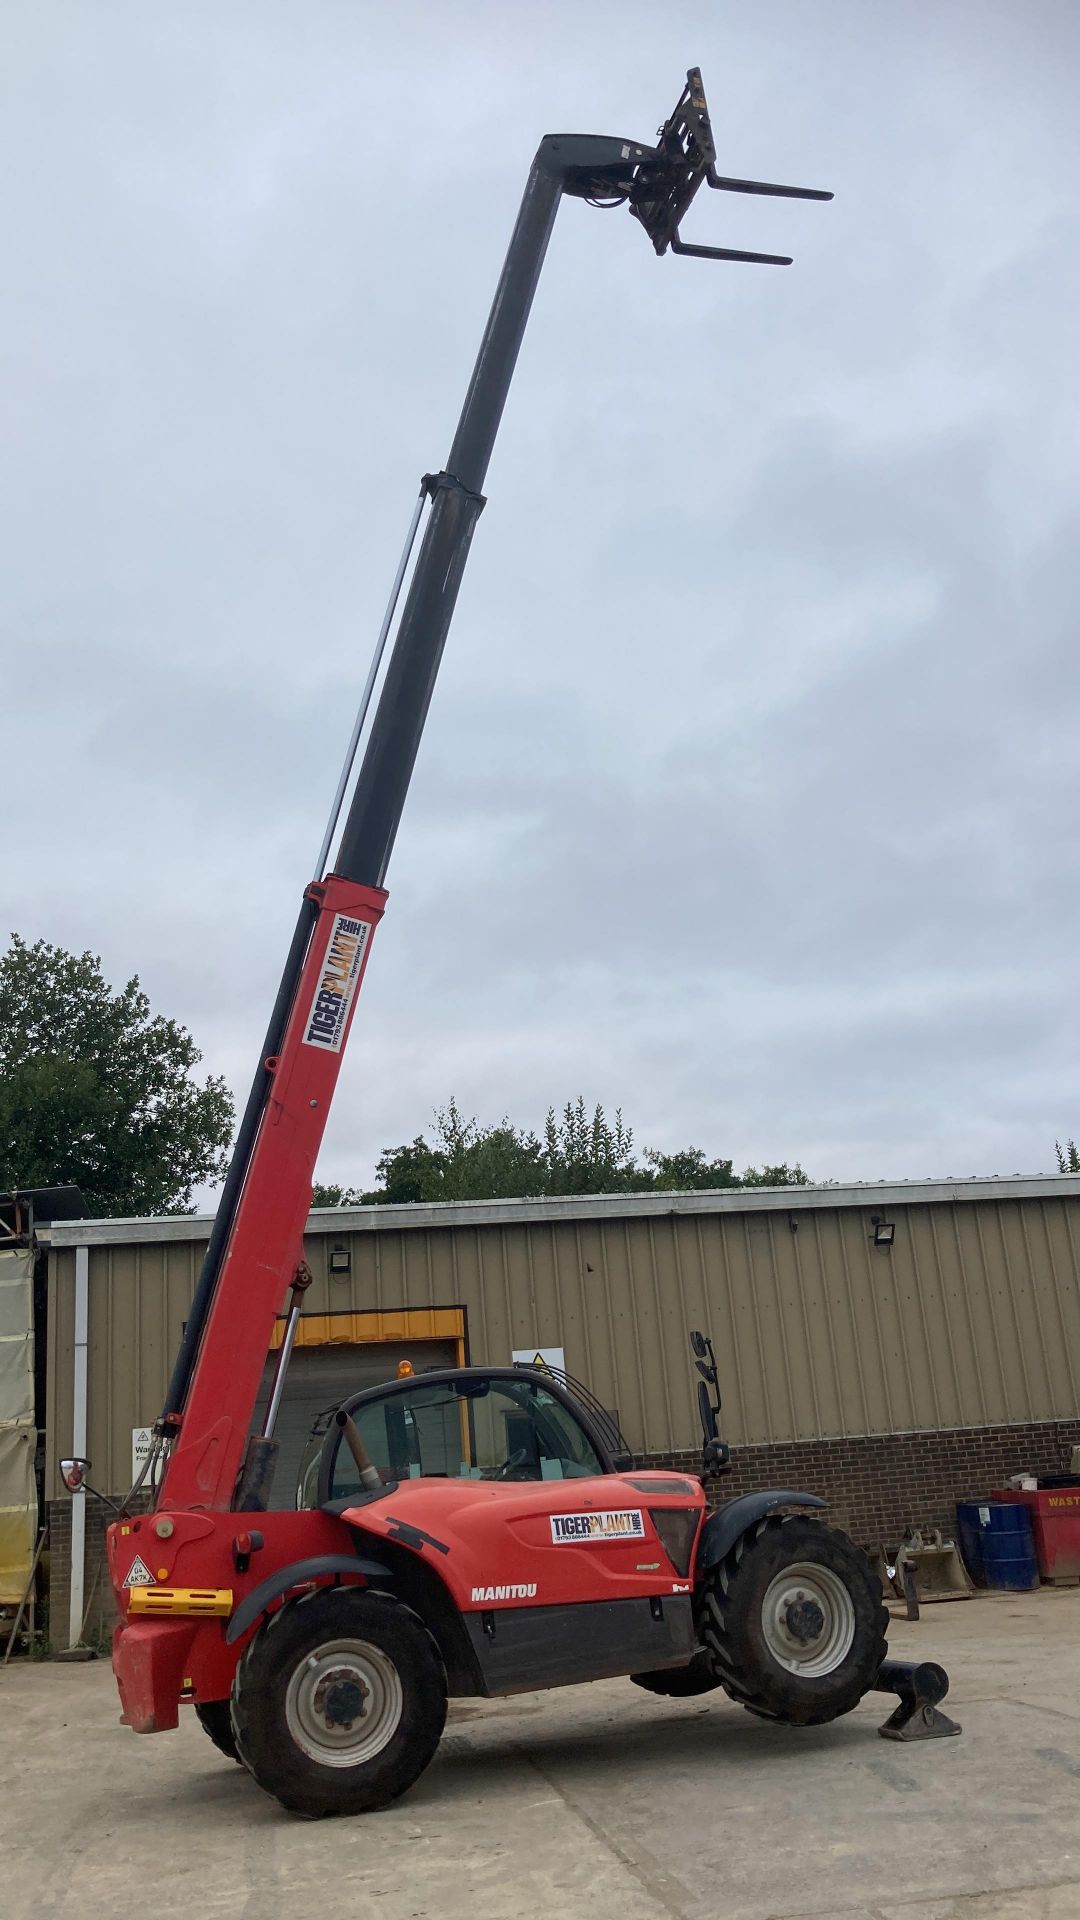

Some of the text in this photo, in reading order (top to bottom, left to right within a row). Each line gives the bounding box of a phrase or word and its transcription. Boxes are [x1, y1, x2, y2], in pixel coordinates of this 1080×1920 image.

[337, 918, 361, 935] HIRE
[332, 1024, 342, 1045] 01793
[631, 1512, 642, 1530] HIRE
[471, 1583, 538, 1602] MANITOU
